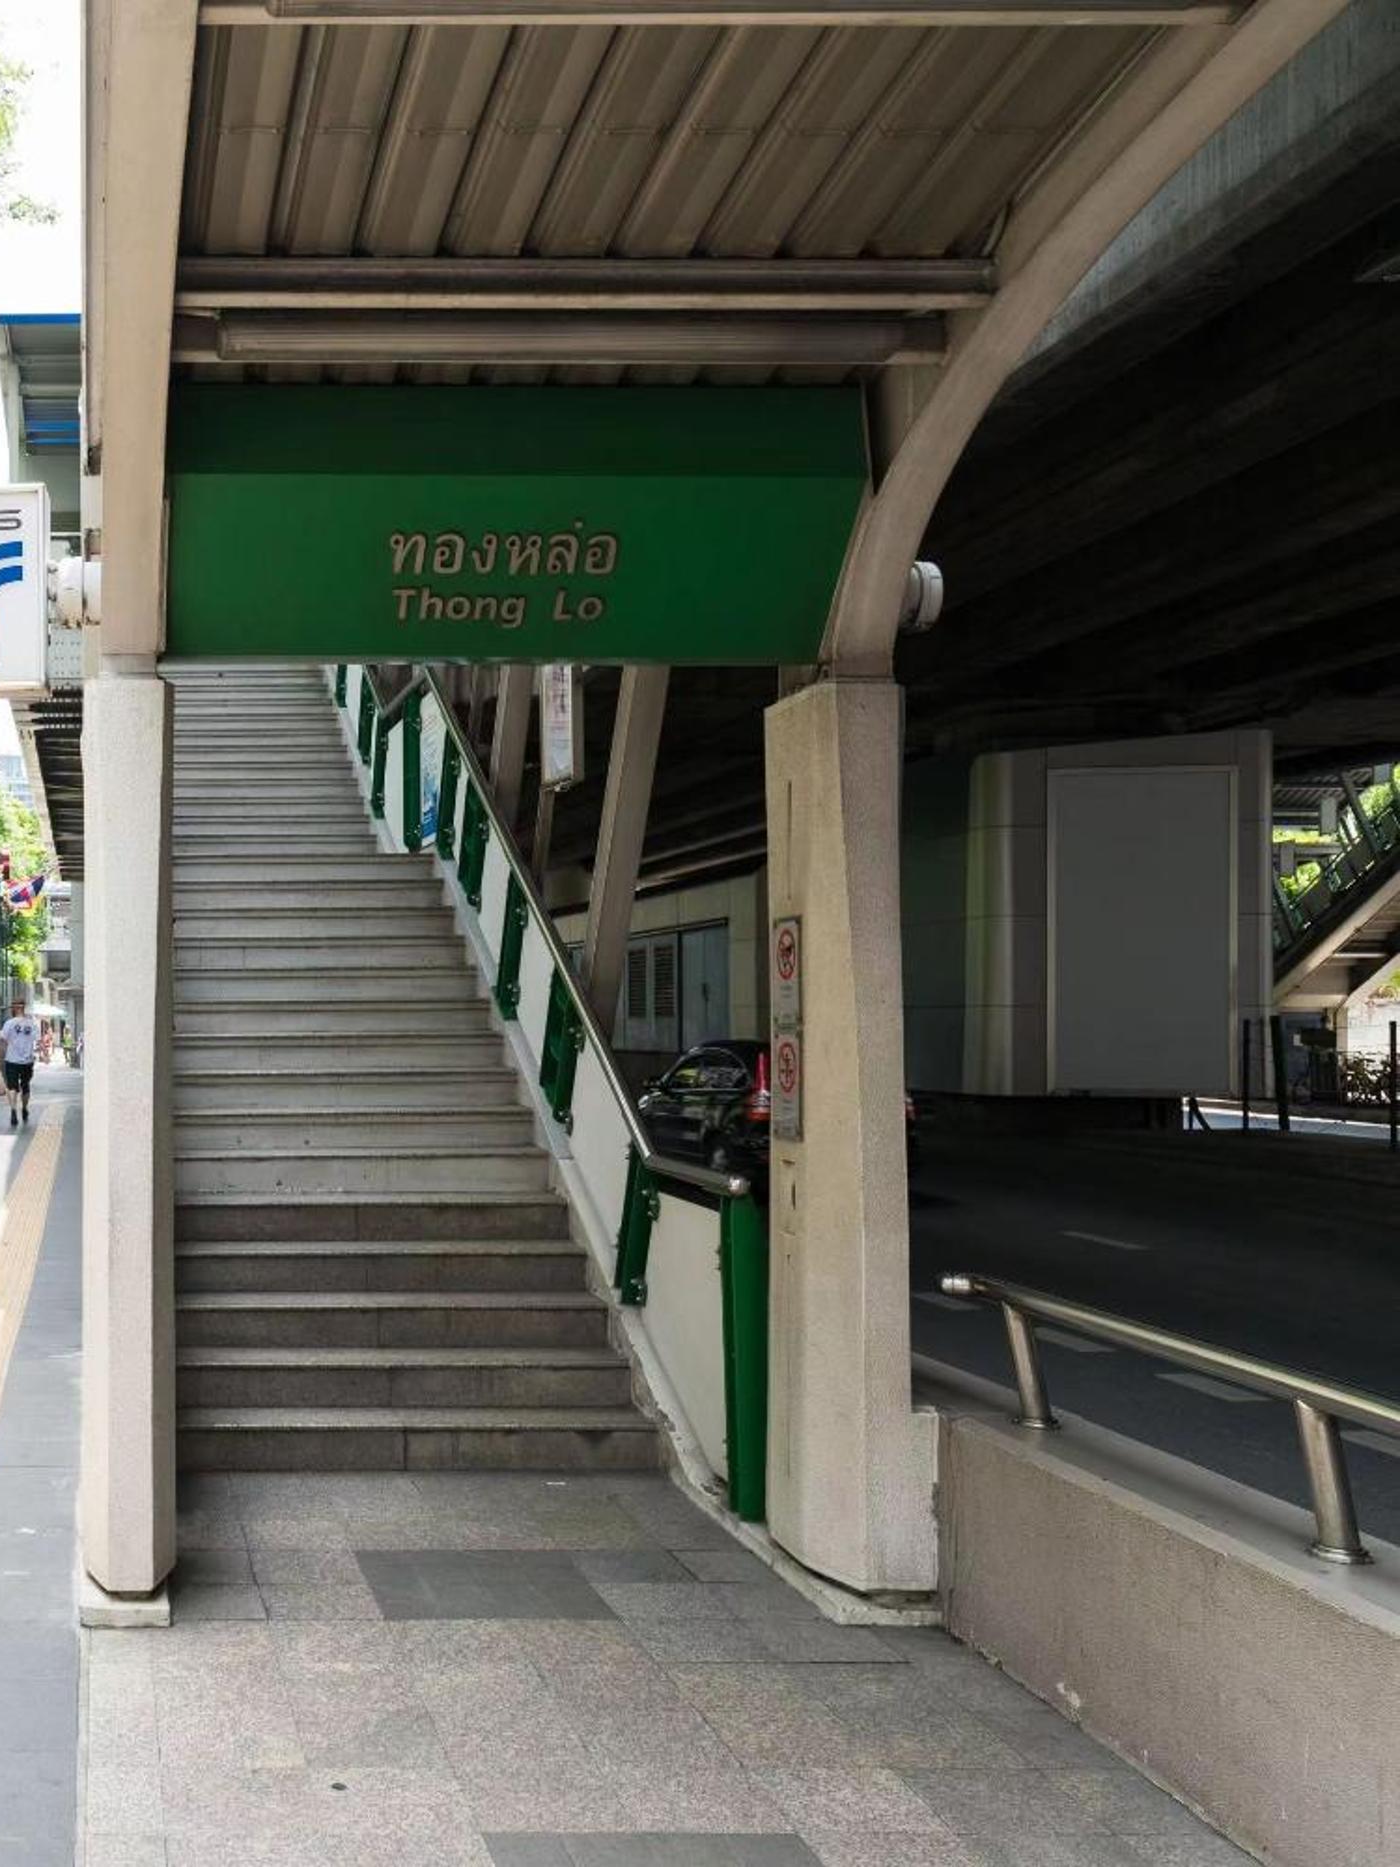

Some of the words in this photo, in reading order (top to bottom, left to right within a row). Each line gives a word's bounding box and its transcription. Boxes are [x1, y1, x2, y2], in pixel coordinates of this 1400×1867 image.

[390, 520, 617, 575] ทองหล่อ
[392, 587, 526, 629] Thong
[552, 589, 604, 621] Lo
